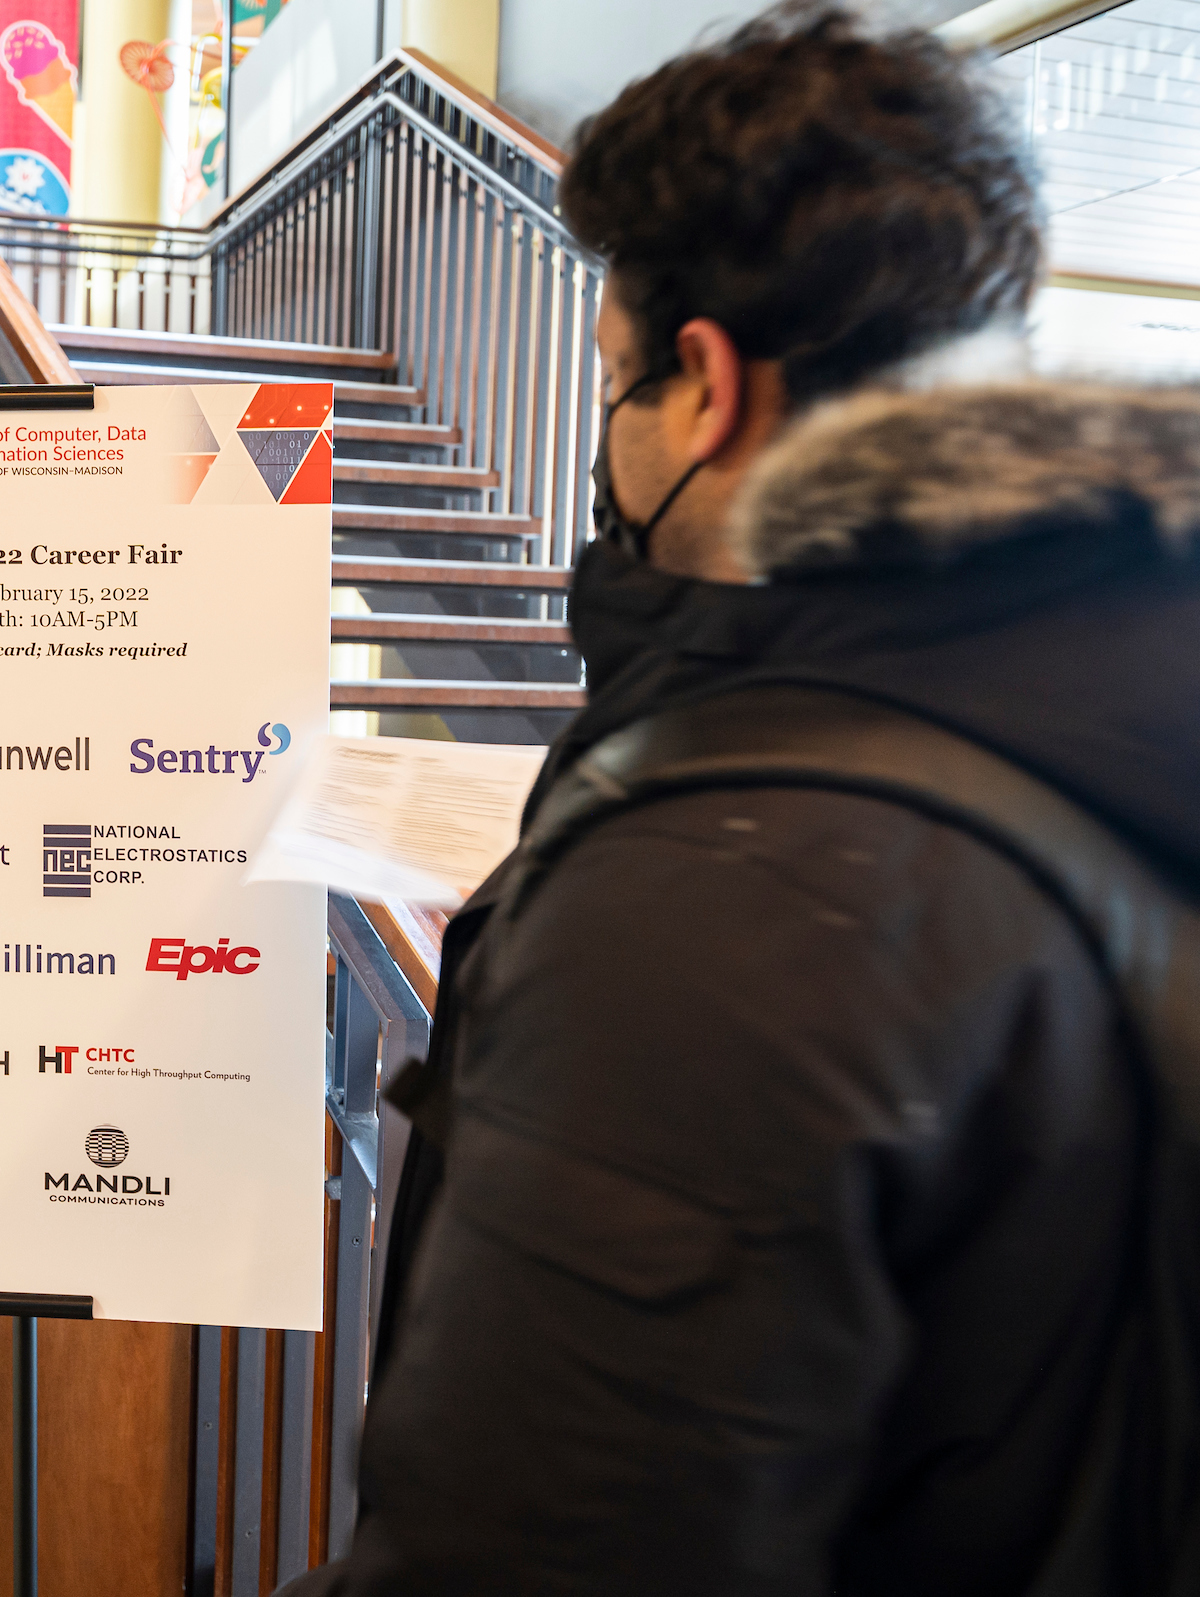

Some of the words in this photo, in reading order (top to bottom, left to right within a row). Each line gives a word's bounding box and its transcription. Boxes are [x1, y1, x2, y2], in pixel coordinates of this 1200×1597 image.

[15, 425, 102, 448] Computer,
[107, 425, 147, 442] Data
[53, 445, 125, 462] Sciences
[30, 544, 121, 566] Career
[127, 542, 183, 565] Fair
[69, 587, 94, 605] 15,
[100, 587, 149, 602] 2022
[30, 610, 139, 631] 10AM-5PM
[45, 642, 105, 658] Masks
[108, 642, 188, 661] required
[93, 824, 181, 840] NATIONAL
[93, 847, 248, 864] ELECTROSTATICS
[93, 869, 146, 885] CORP.
[145, 938, 261, 981] Epic
[38, 1045, 80, 1075] HT
[85, 1047, 136, 1063] CHTC
[87, 1066, 114, 1077] Center
[116, 1066, 128, 1077] for
[130, 1067, 151, 1080] High
[152, 1068, 202, 1081] Throughput
[204, 1070, 252, 1083] Computing
[44, 1171, 171, 1197] MANDLI
[48, 1193, 166, 1208] COMMUNICATIONS
